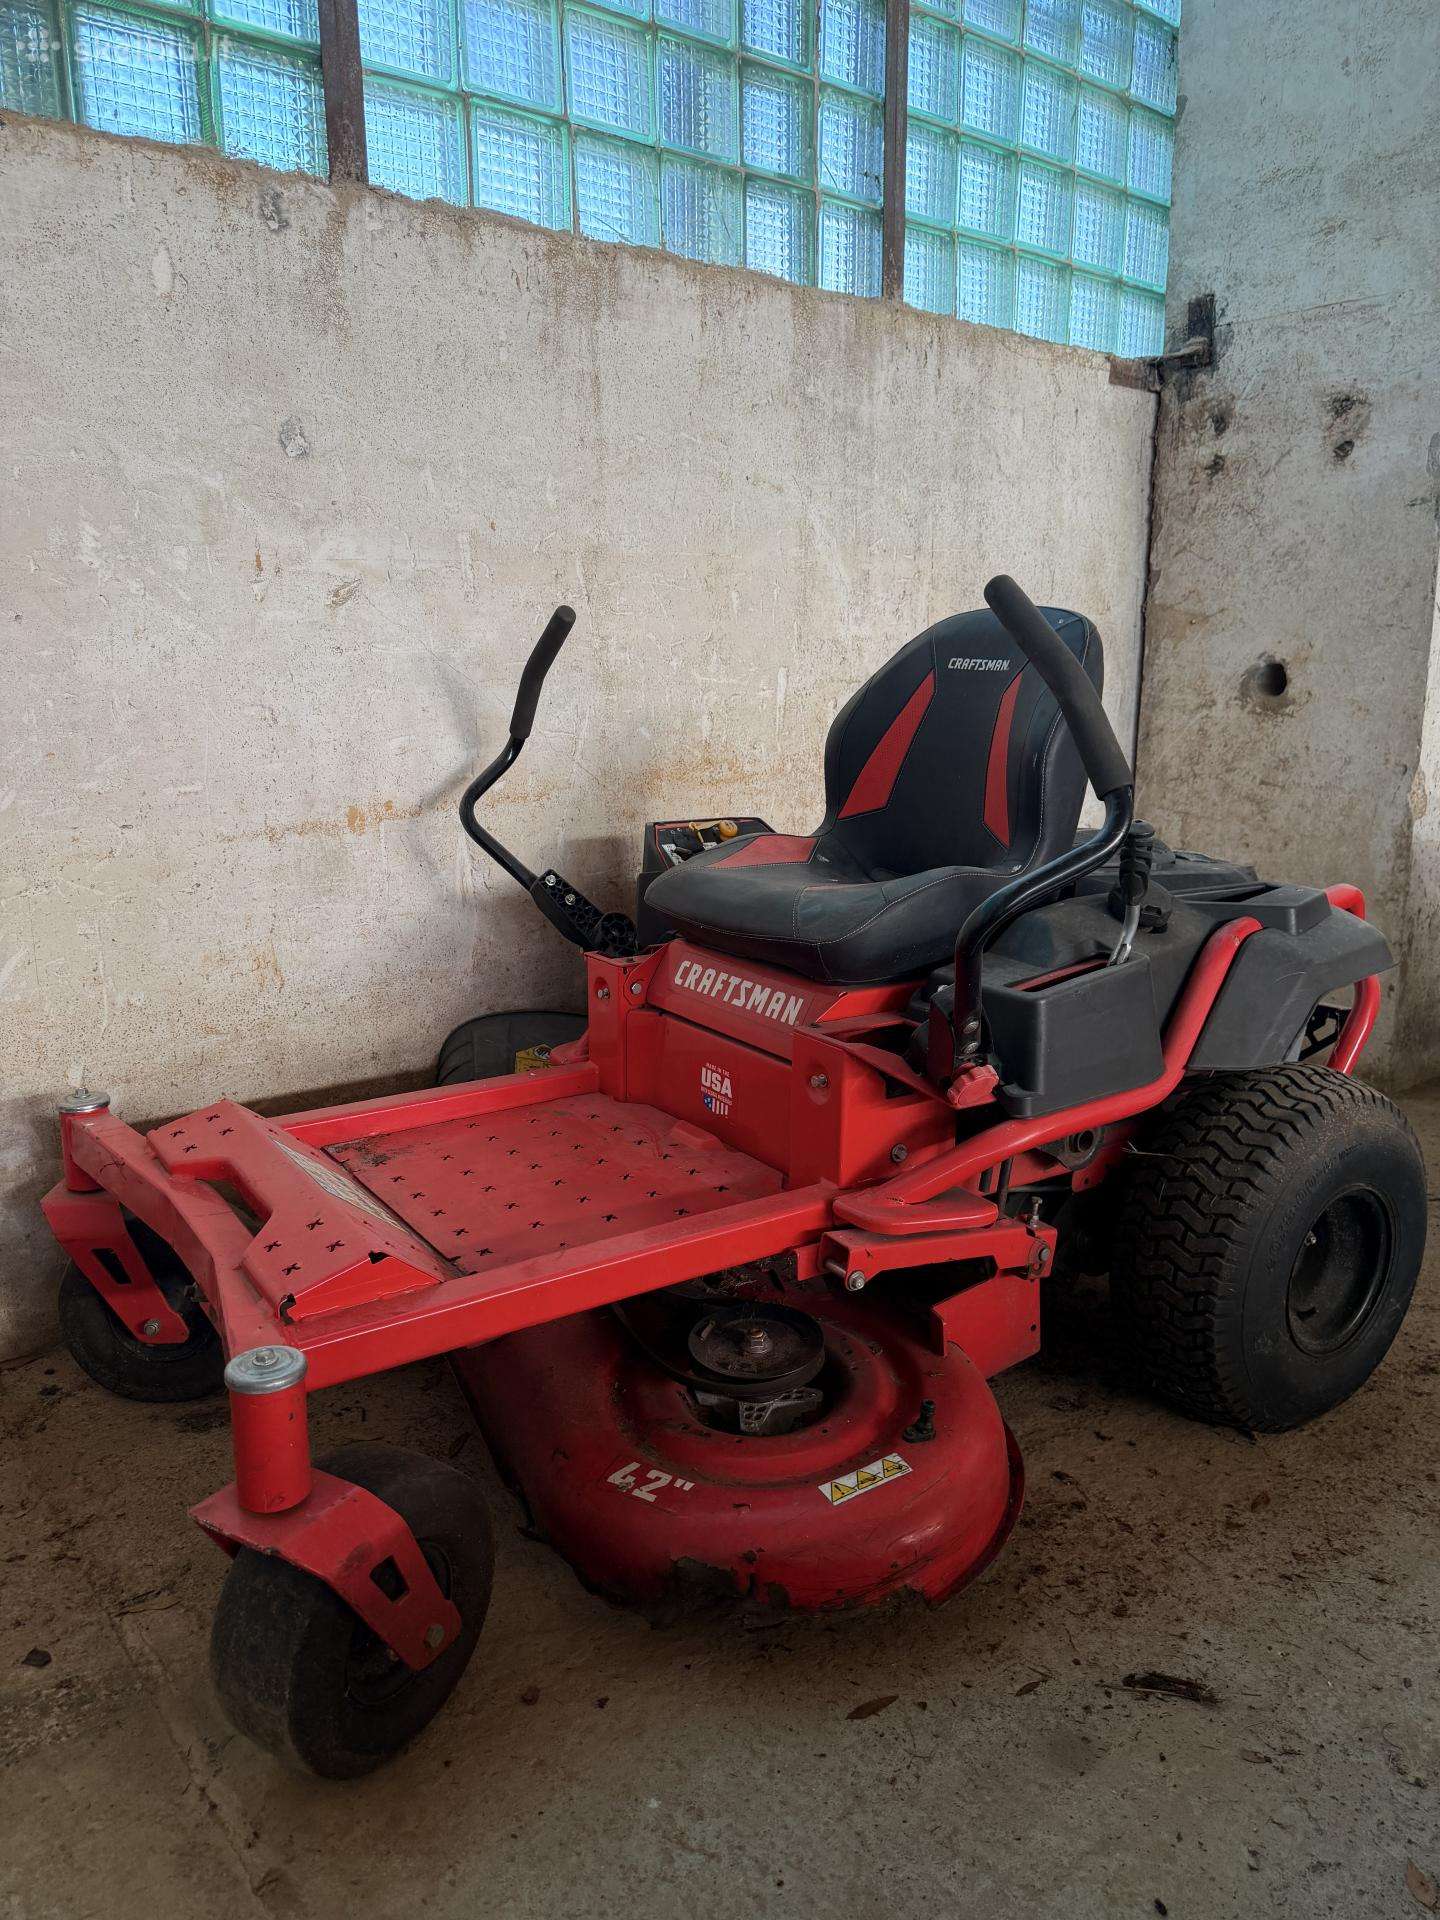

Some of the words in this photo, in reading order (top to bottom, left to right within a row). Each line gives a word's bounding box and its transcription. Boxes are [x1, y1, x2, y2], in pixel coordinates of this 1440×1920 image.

[948, 657, 1010, 671] CRAFTSMAN
[674, 960, 804, 1026] CRAFTSMAN
[701, 1066, 733, 1099] USA
[606, 1462, 696, 1502] 42"
